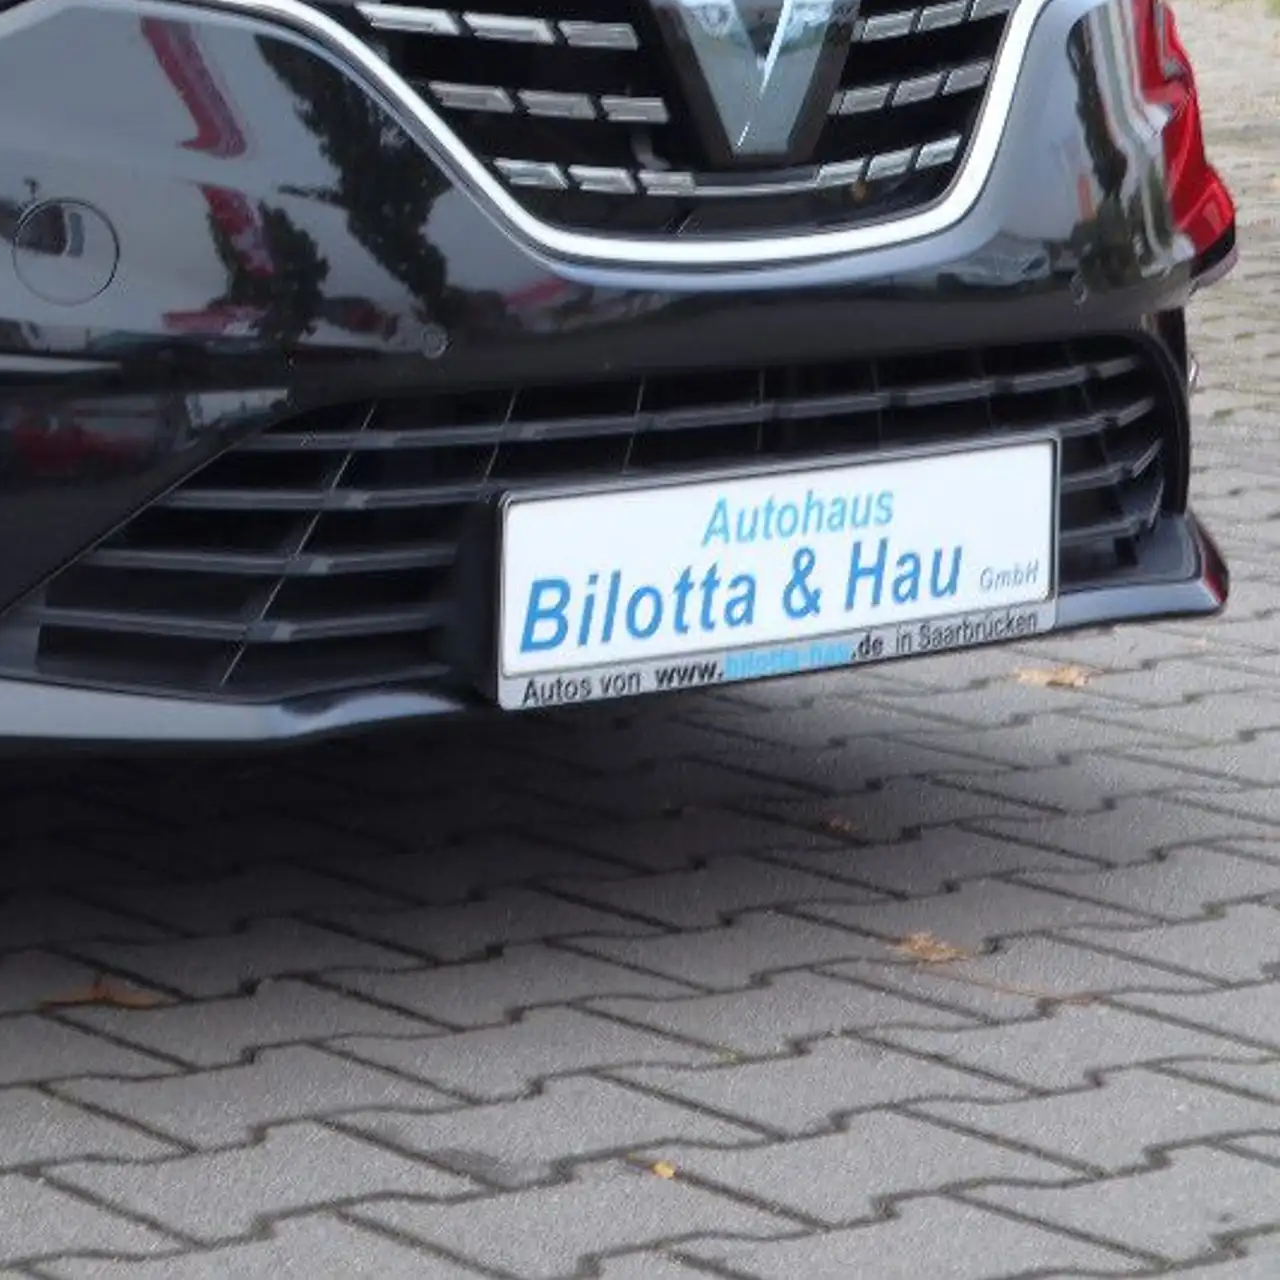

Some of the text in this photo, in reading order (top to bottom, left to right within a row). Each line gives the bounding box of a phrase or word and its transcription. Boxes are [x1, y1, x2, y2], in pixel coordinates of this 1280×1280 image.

[701, 489, 895, 547] Autohaus
[521, 538, 1040, 654] Bilotta & Hau GmbH
[521, 674, 592, 707] Autos
[599, 672, 641, 696] von
[896, 624, 913, 653] in
